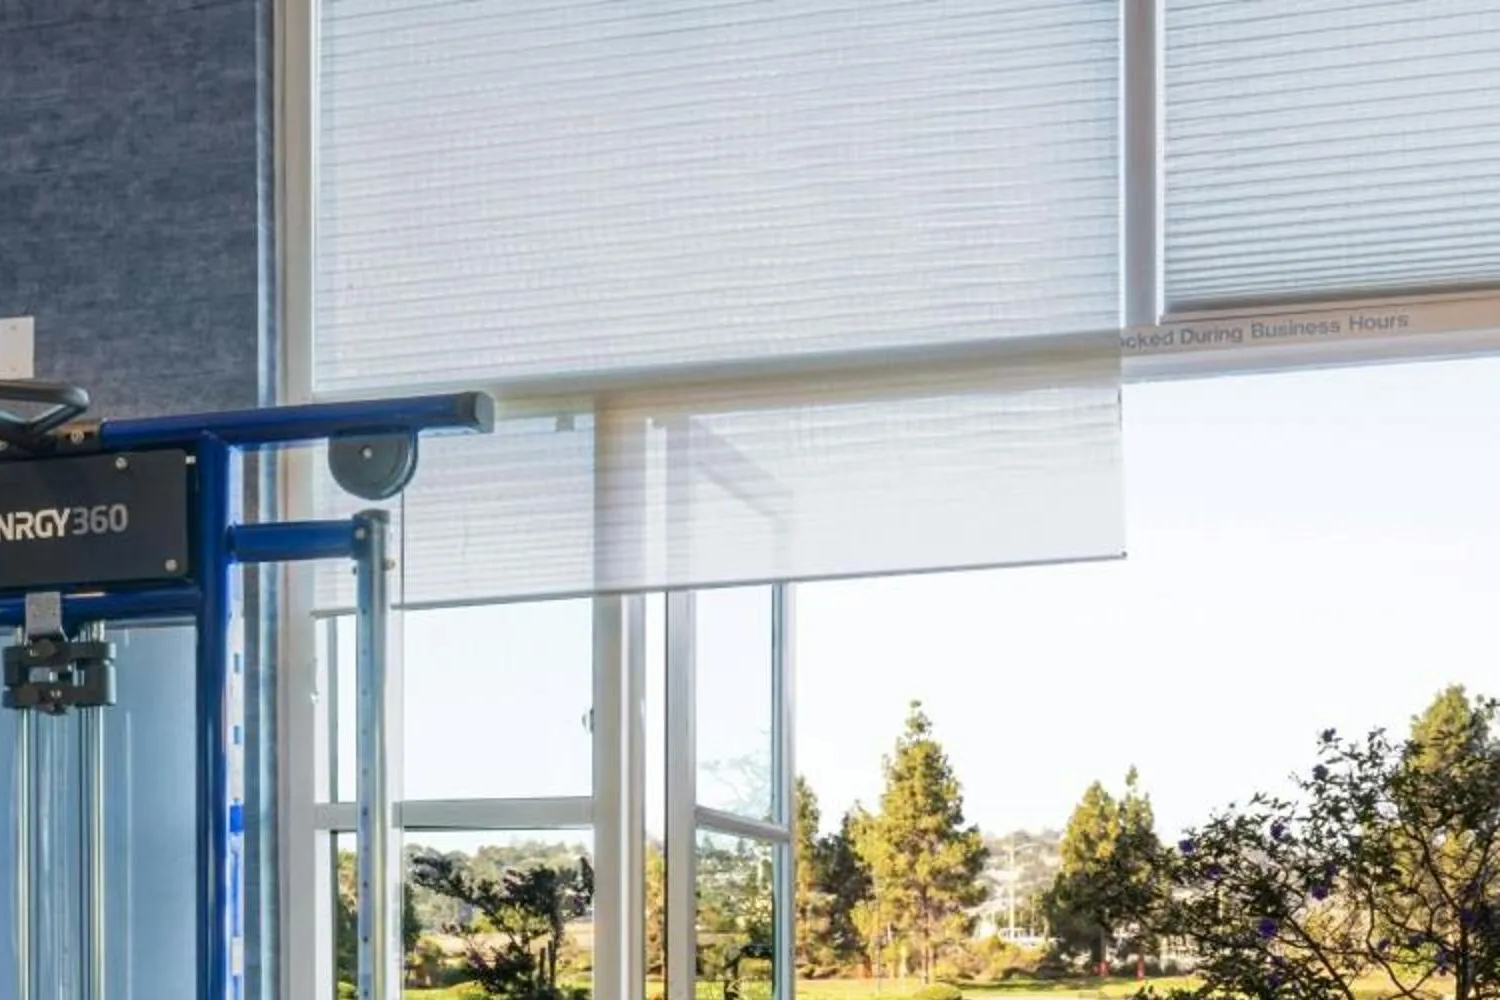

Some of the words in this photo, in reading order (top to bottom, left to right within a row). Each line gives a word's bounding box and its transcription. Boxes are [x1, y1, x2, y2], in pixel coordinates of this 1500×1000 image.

[1180, 326, 1244, 345] During
[1251, 319, 1341, 339] Business
[1350, 313, 1410, 331] Hours
